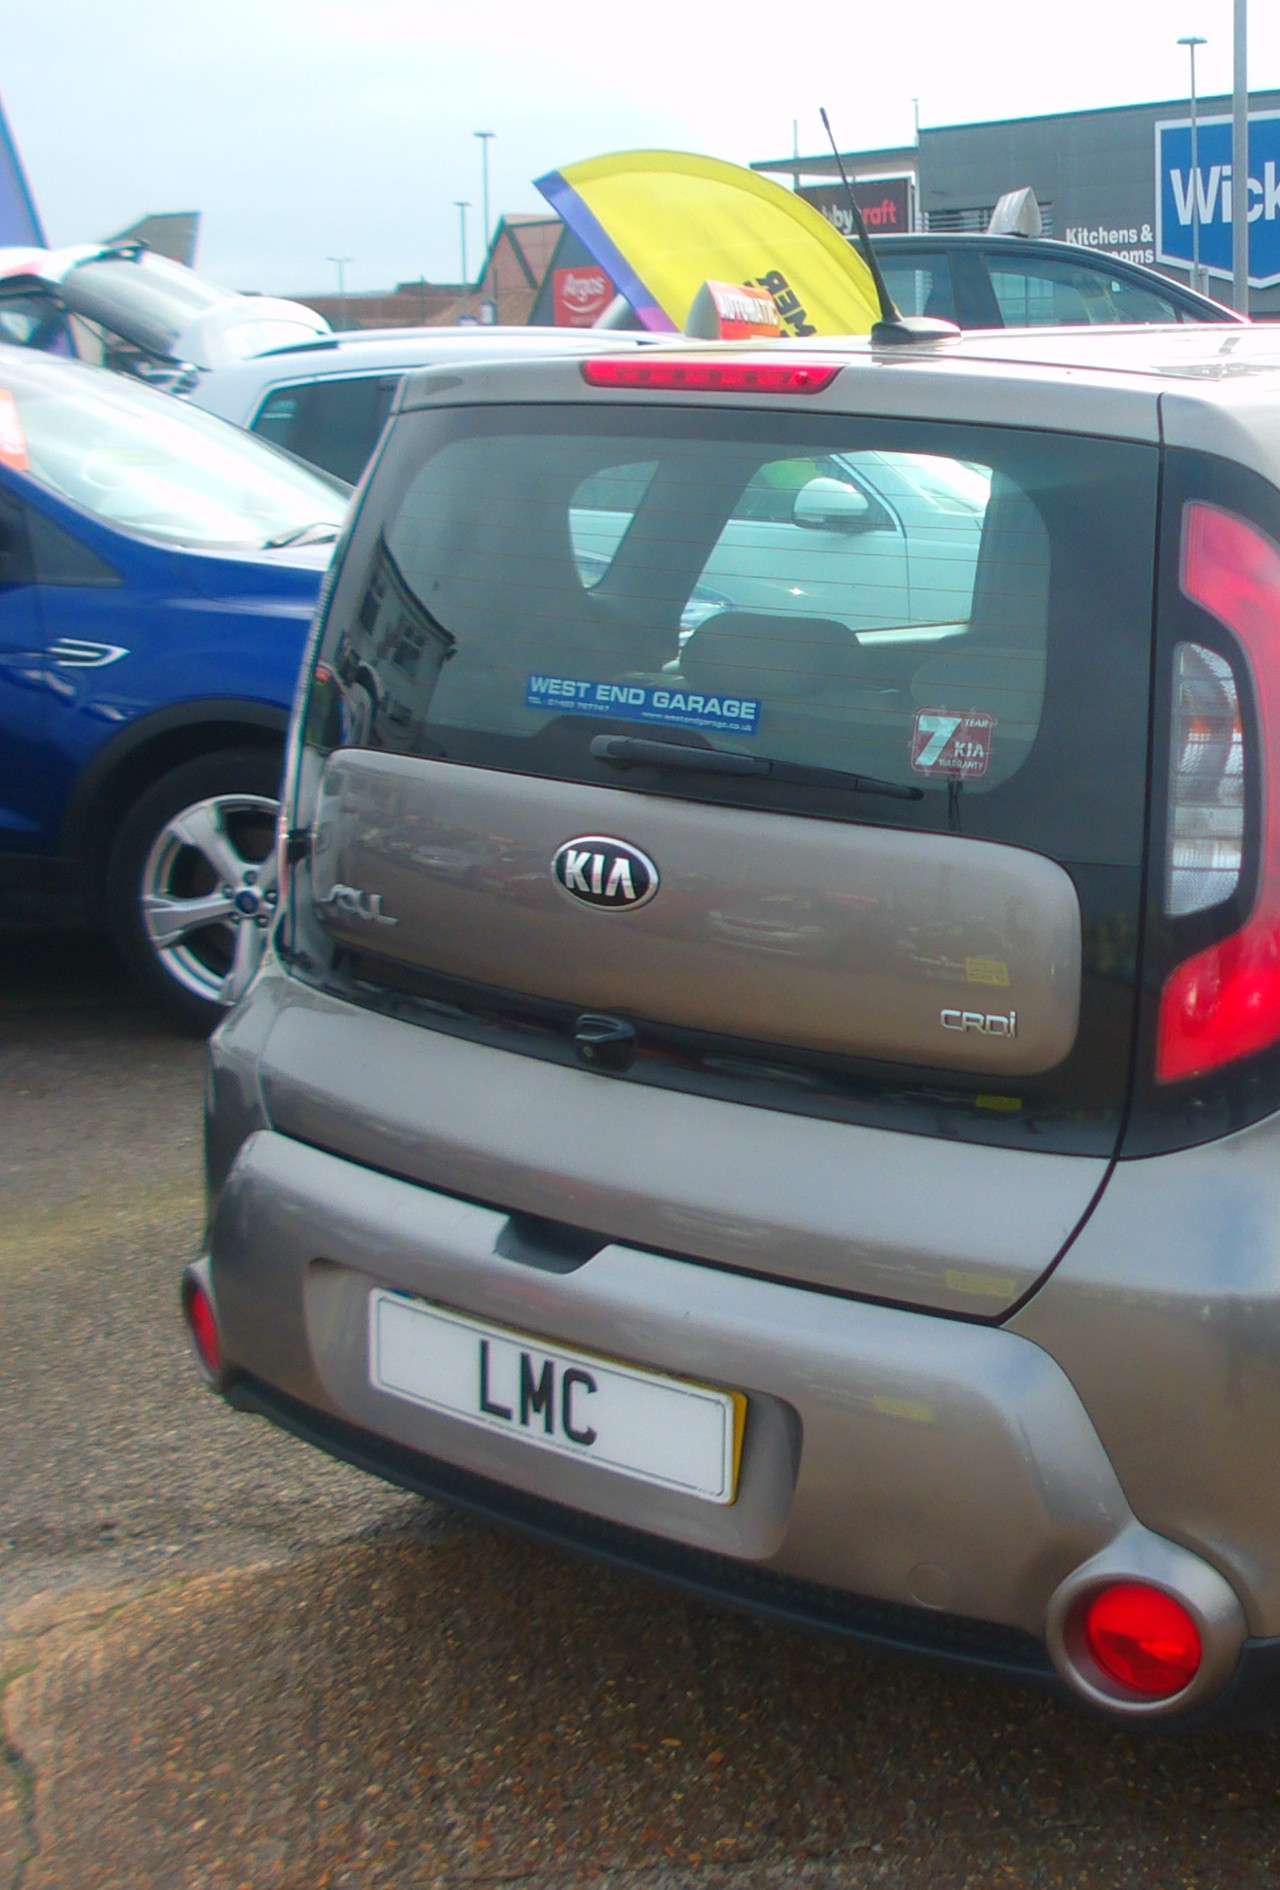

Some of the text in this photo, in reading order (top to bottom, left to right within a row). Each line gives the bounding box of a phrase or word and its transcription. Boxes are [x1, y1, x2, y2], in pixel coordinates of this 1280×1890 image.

[1065, 224, 1153, 245] Kitchens &
[531, 676, 591, 698] WEST
[596, 685, 646, 705] END
[652, 691, 757, 719] GARAGE
[914, 714, 962, 767] 7
[954, 741, 985, 757] KIA
[564, 849, 637, 900] KIA
[478, 1338, 599, 1447] LMC
